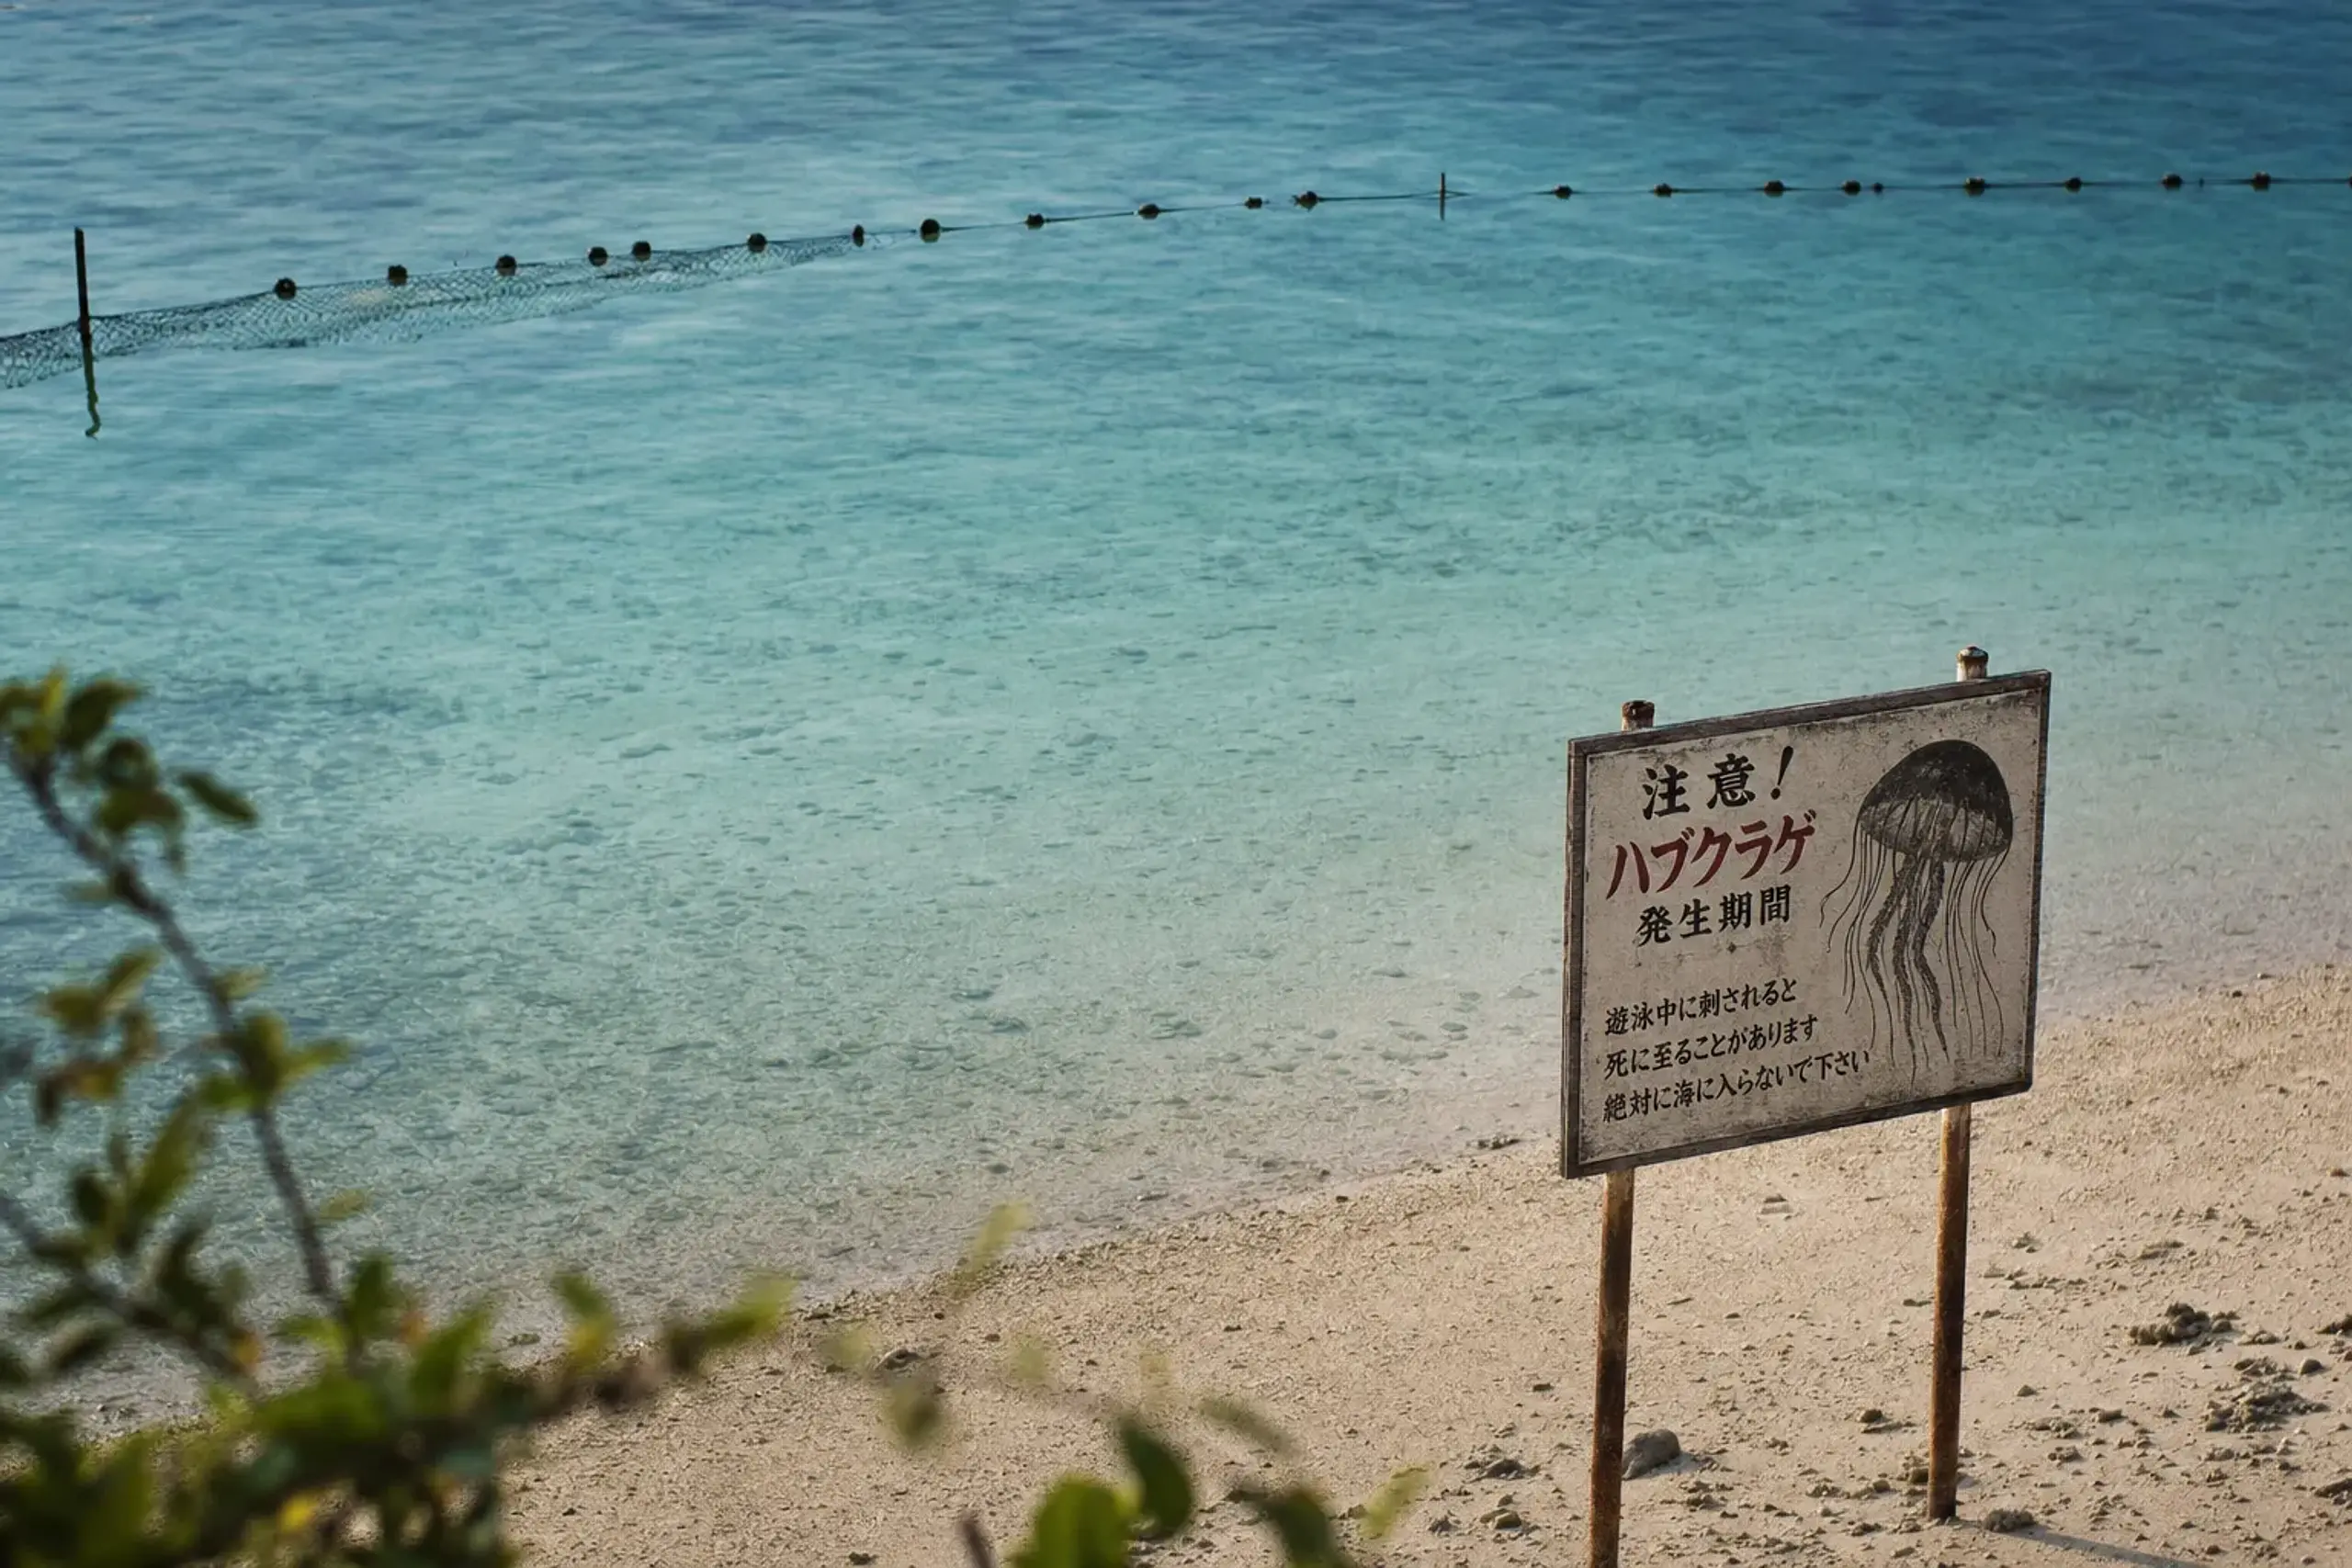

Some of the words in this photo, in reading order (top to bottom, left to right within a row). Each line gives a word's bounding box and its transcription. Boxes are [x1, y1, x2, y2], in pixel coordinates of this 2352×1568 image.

[1606, 809, 1816, 900] ハブクラゲ
[1636, 884, 1792, 948] 発生期間
[1605, 978, 1797, 1036] 遊泳中に刺されると
[1605, 1013, 1818, 1080] 死に至ることがあります
[1602, 1050, 1870, 1123] 絶対に海に入らないで下さい
